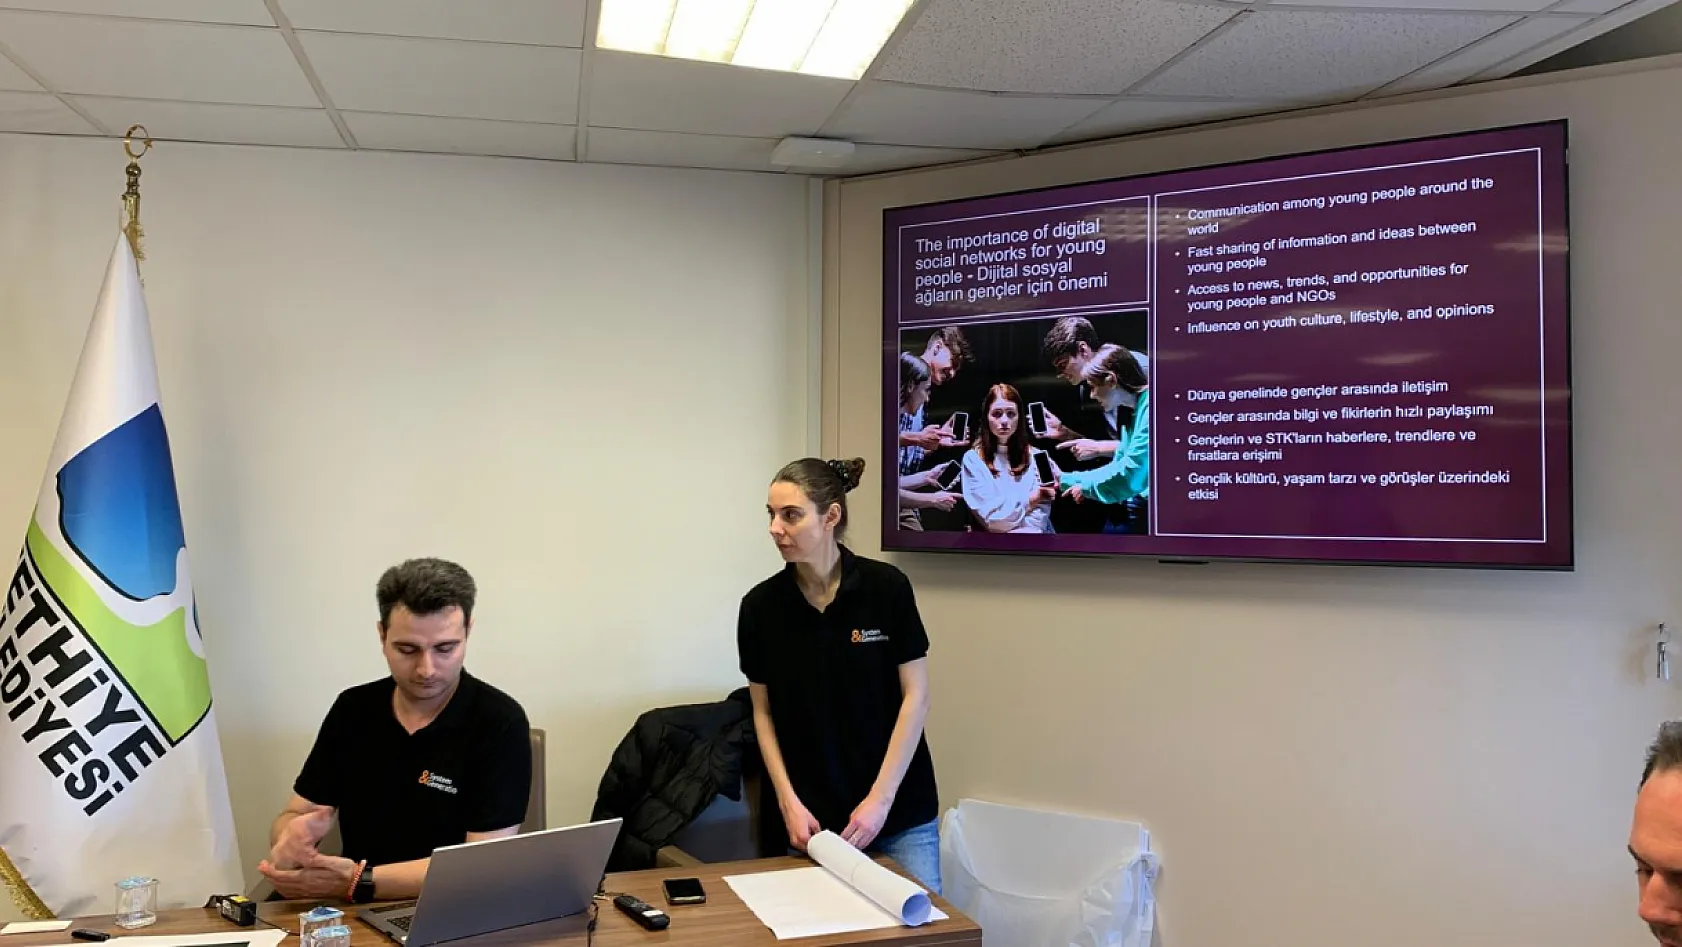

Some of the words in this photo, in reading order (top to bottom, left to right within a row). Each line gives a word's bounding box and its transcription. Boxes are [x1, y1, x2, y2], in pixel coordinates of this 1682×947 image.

[1188, 201, 1279, 220] Communication
[1283, 197, 1325, 210] among
[1328, 192, 1367, 207] young
[1372, 185, 1416, 202] people
[1420, 179, 1467, 195] around
[1471, 178, 1493, 190] the
[916, 239, 942, 253] The
[947, 230, 1028, 251] importance
[1033, 225, 1048, 239] of
[1054, 218, 1099, 239] digital
[1188, 222, 1218, 235] world
[1188, 246, 1213, 257] Fast
[1216, 242, 1260, 254] sharing
[1264, 239, 1276, 250] of
[1279, 233, 1347, 249] information
[1351, 229, 1374, 243] and
[1380, 228, 1414, 239] ideas
[1418, 222, 1476, 236] between
[916, 254, 955, 269] social
[960, 247, 1026, 265] networks
[1032, 244, 1051, 258] for
[1057, 239, 1105, 255] young
[1187, 261, 1222, 275] young
[1227, 256, 1266, 272] people
[916, 270, 963, 289] people
[978, 263, 1018, 282] Dijital
[1022, 258, 1071, 277] sosyal
[1188, 284, 1229, 295] Access
[1233, 281, 1244, 291] to
[1248, 279, 1283, 289] news,
[1287, 274, 1329, 287] trends,
[1334, 272, 1356, 283] and
[1361, 265, 1446, 283] opportunities
[1450, 262, 1469, 274] for
[916, 289, 963, 306] ağların
[968, 282, 1022, 302] gençler
[1028, 279, 1053, 296] için
[1058, 272, 1108, 291] önemi
[1187, 299, 1222, 313] young
[1227, 295, 1266, 309] people
[1270, 293, 1293, 304] and
[1297, 290, 1336, 302] NGOs
[1188, 322, 1240, 333] Influence
[1244, 320, 1258, 329] on
[1262, 316, 1296, 331] youth
[1301, 313, 1346, 326] culture,
[1351, 309, 1402, 323] lifestyle,
[1407, 306, 1432, 319] and
[1436, 303, 1494, 319] opinions
[1188, 390, 1225, 402] Dünya
[1229, 386, 1287, 402] genelinde
[1291, 385, 1337, 399] gençler
[1341, 382, 1398, 395] arasında
[1402, 381, 1448, 395] iletişim
[1188, 412, 1234, 425] Gençler
[1237, 410, 1290, 421] arasında
[1294, 409, 1319, 422] bilgi
[1323, 410, 1337, 419] ve
[1341, 407, 1391, 419] fikirlerin
[1396, 405, 1423, 418] hızlı
[1428, 405, 1493, 419] paylaşımı
[1188, 434, 1244, 447] Gençlerin
[1266, 432, 1322, 444] STK'ların
[1326, 431, 1391, 443] haberlere,
[1396, 429, 1455, 442] trendlere
[1460, 432, 1476, 440] ve
[1188, 450, 1239, 461] fırsatlara
[1243, 449, 1282, 463] erişimi
[1188, 472, 1232, 486] Gençlik
[1236, 472, 1280, 485] kültürü,
[1283, 474, 1325, 486] yaşam
[1329, 472, 1356, 484] tarzı
[1360, 474, 1376, 483] ve
[1380, 471, 1434, 486] görüşler
[1439, 471, 1510, 483] üzerindeki
[1188, 489, 1218, 500] etkisi
